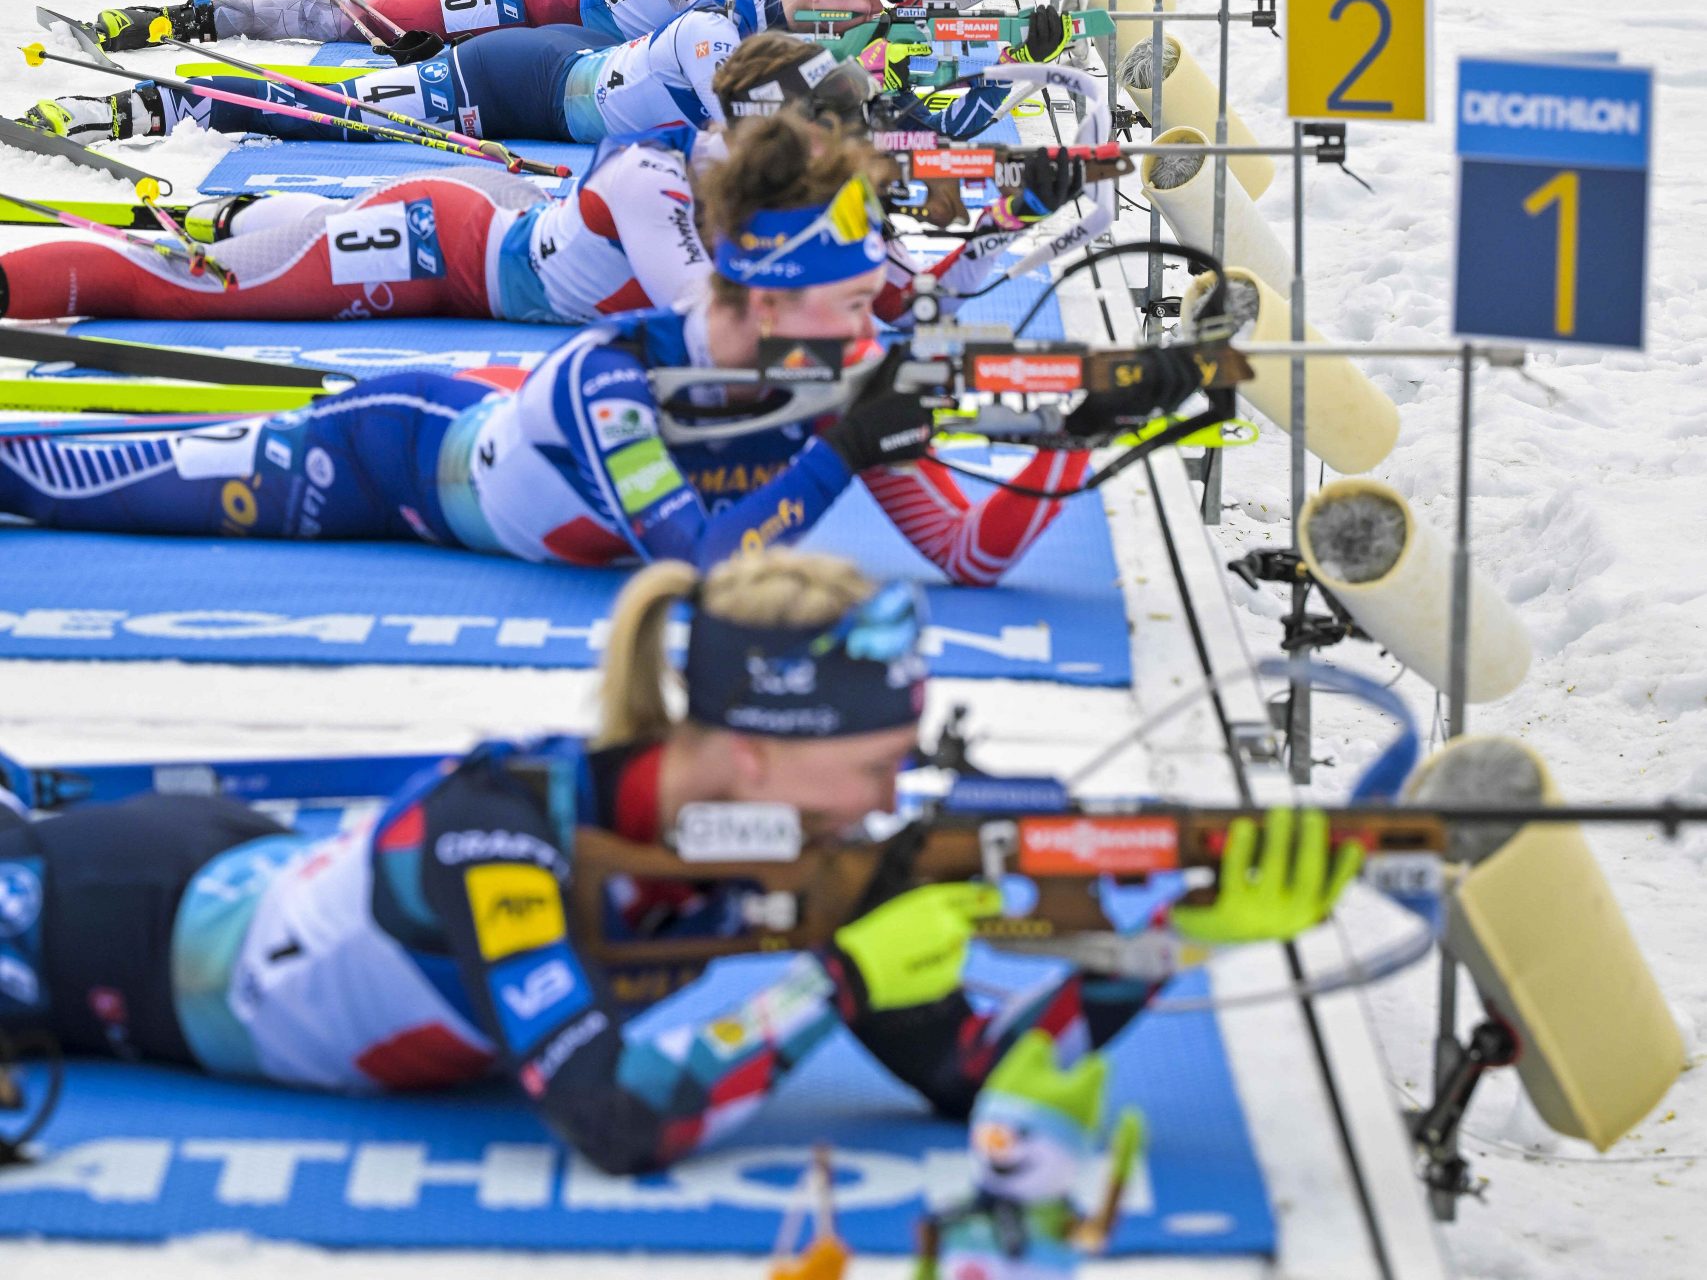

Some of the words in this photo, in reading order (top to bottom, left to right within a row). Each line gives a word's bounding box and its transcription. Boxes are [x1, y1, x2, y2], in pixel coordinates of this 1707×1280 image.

[897, 8, 926, 17] Patria
[936, 21, 999, 36] VIESSMANN
[607, 70, 625, 90] 4
[1045, 72, 1083, 91] JOKA
[362, 84, 416, 103] 4
[1463, 90, 1642, 136] DECATHLON
[915, 151, 993, 172] VIESSMANN
[335, 228, 401, 253] 3
[1050, 225, 1088, 257] JOKA
[1523, 170, 1580, 337] 1
[977, 360, 1081, 383] VIESSMANN
